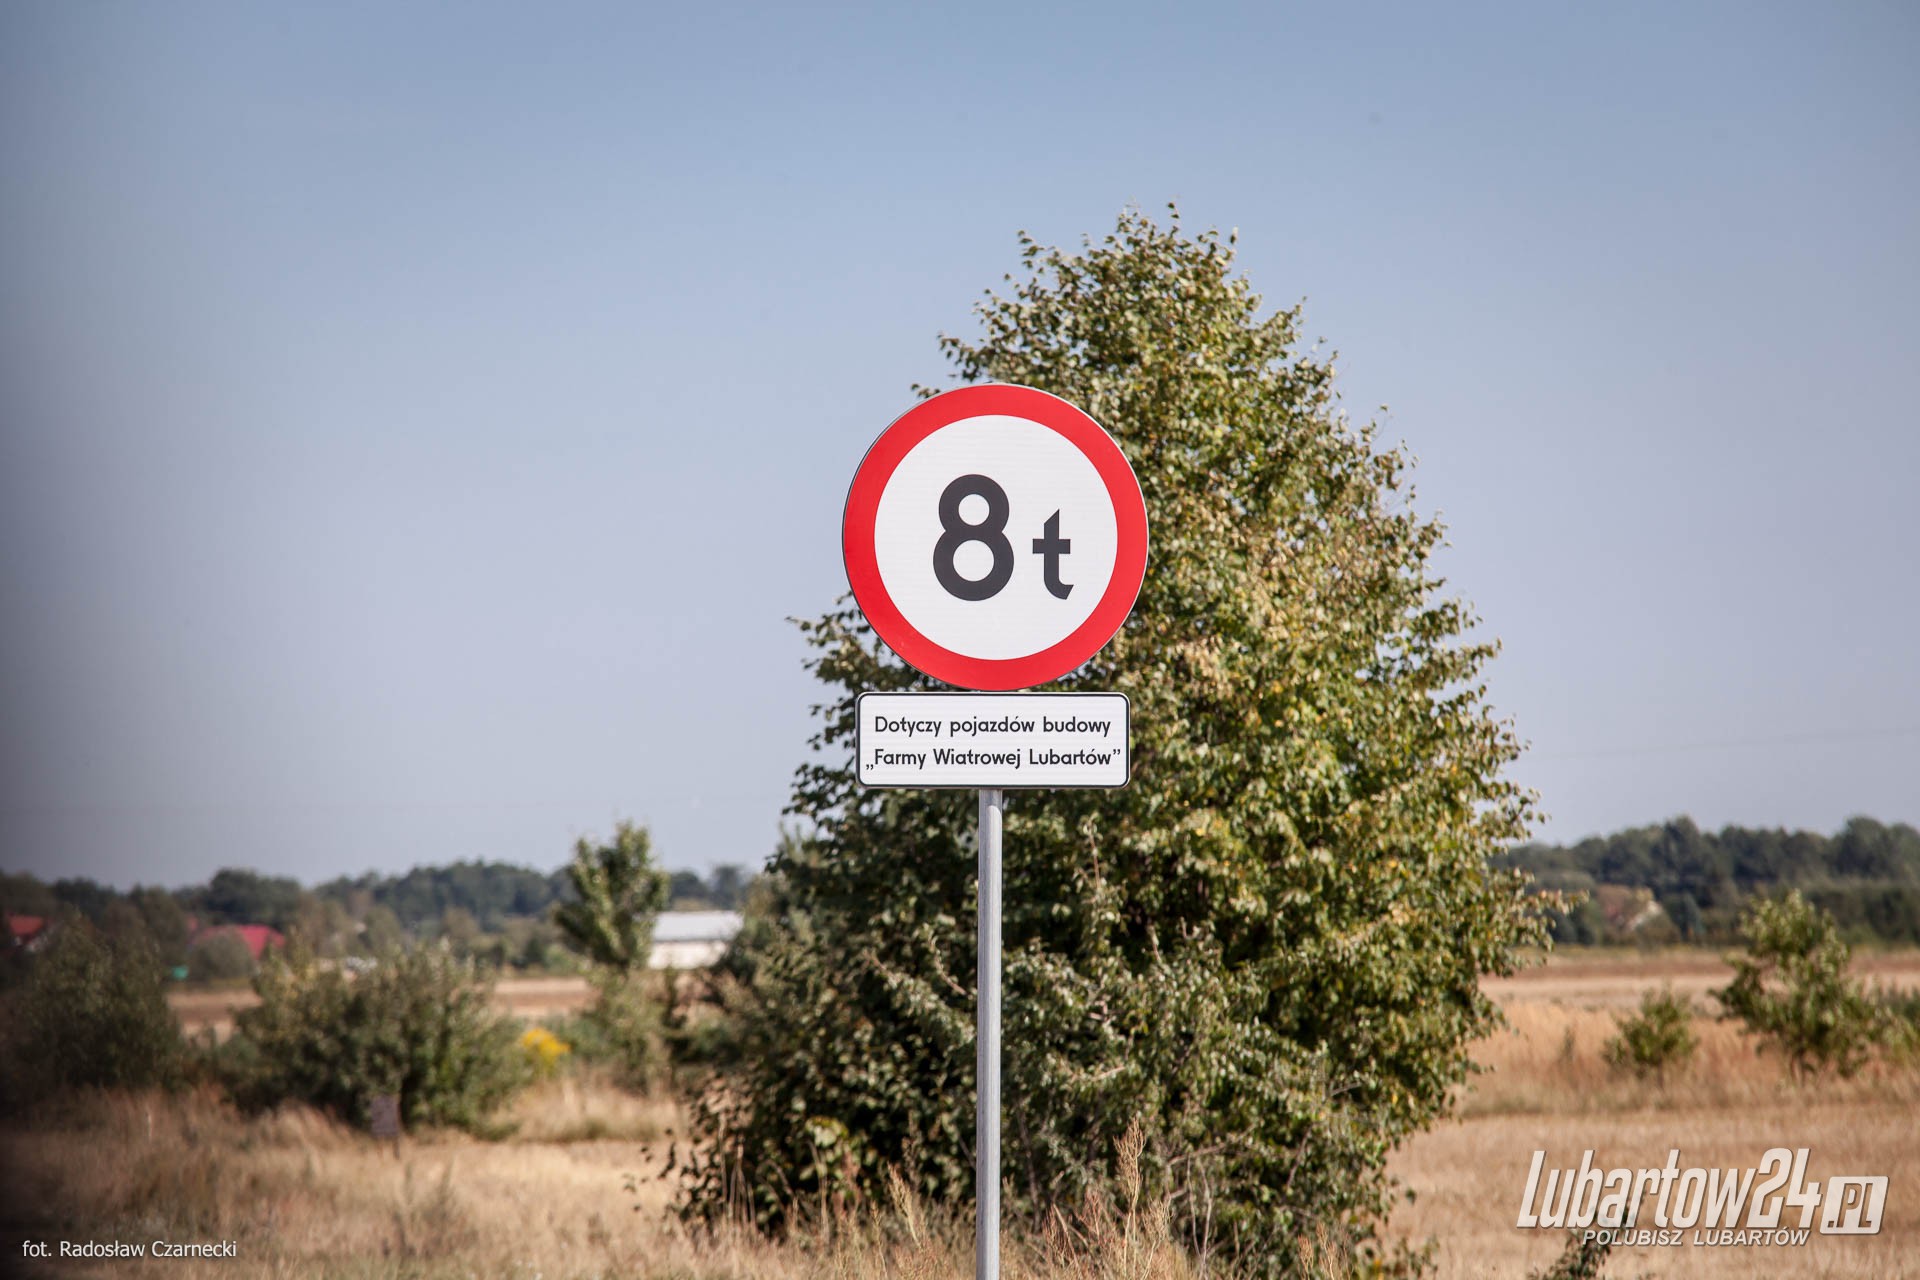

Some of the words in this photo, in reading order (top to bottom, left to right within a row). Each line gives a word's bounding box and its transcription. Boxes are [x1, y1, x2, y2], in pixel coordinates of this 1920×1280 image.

[933, 474, 1014, 601] 8
[1032, 508, 1074, 600] t
[875, 716, 942, 737] Dotyczy
[950, 716, 1035, 737] pojazdów
[1043, 716, 1111, 737] budowy
[933, 748, 1021, 770] Wiatrowej
